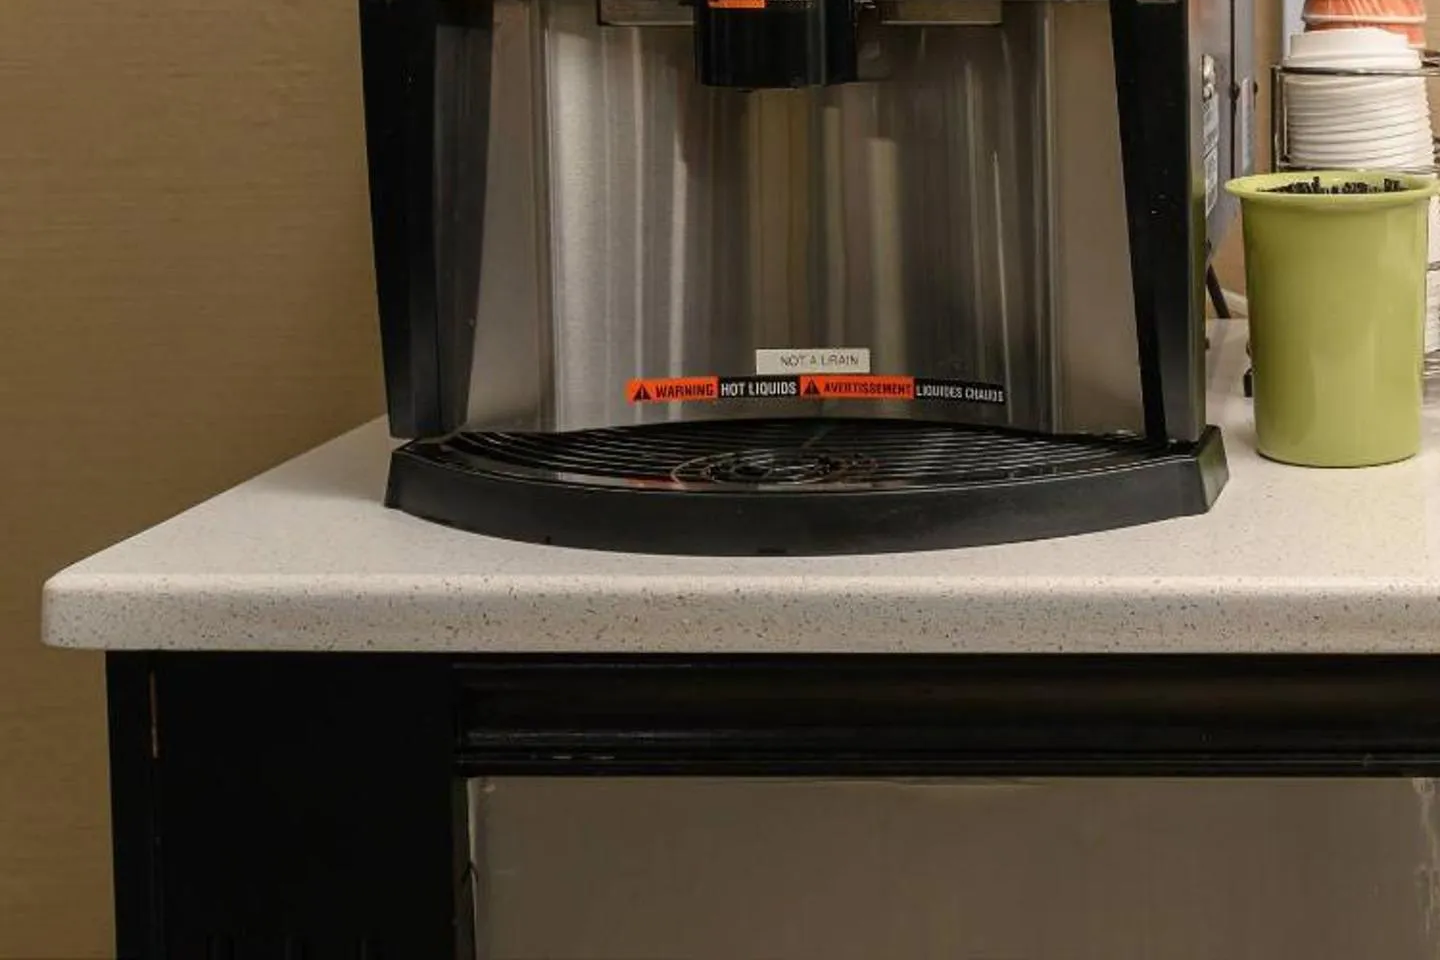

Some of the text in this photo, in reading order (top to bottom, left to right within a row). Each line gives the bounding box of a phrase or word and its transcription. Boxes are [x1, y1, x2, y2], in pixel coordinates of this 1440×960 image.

[780, 354, 808, 367] NOT
[655, 383, 714, 399] WARNING
[721, 383, 746, 398] HOT
[749, 381, 797, 397] LIQUIDS
[824, 381, 911, 395] AVERTISSEMENT
[916, 384, 963, 399] LIQUIDES
